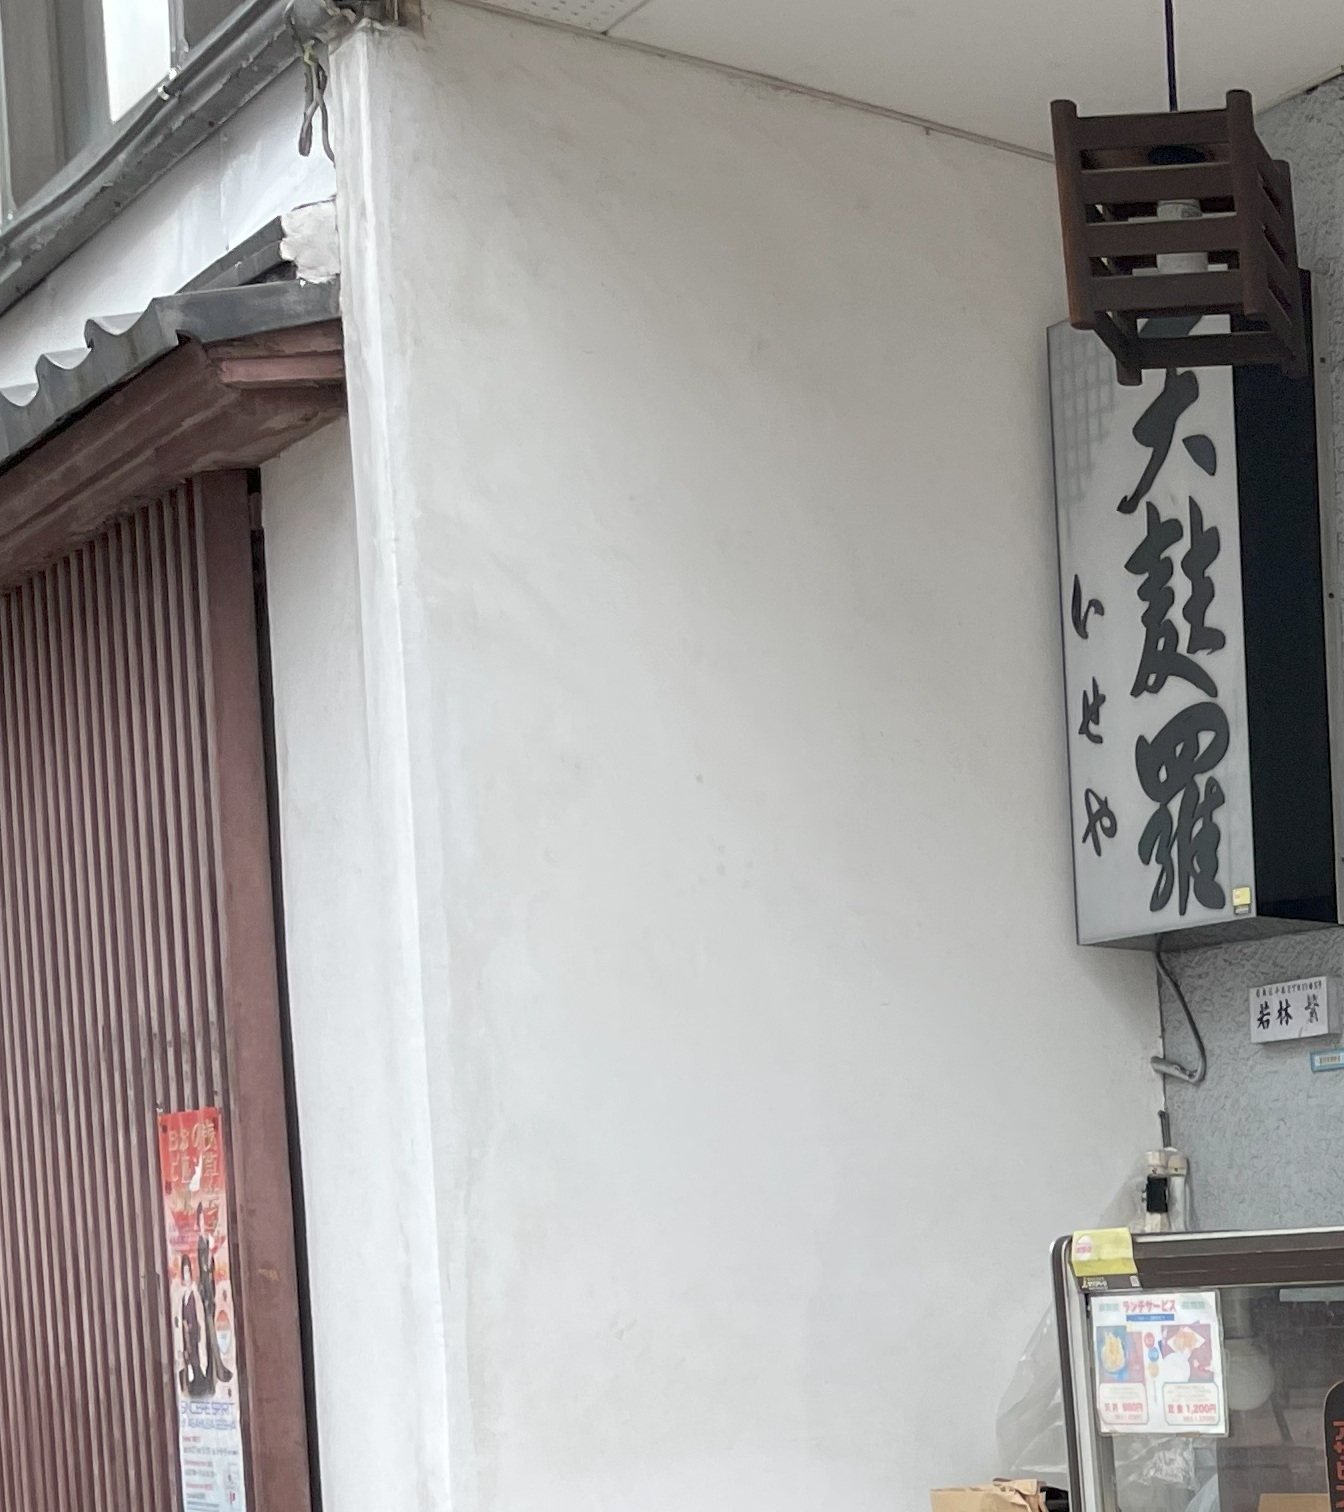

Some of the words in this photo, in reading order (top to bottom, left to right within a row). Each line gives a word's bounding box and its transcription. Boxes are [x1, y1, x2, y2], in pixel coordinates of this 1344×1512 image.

[1072, 574, 1117, 856] いせや
[1123, 1300, 1176, 1313] ランチサービス
